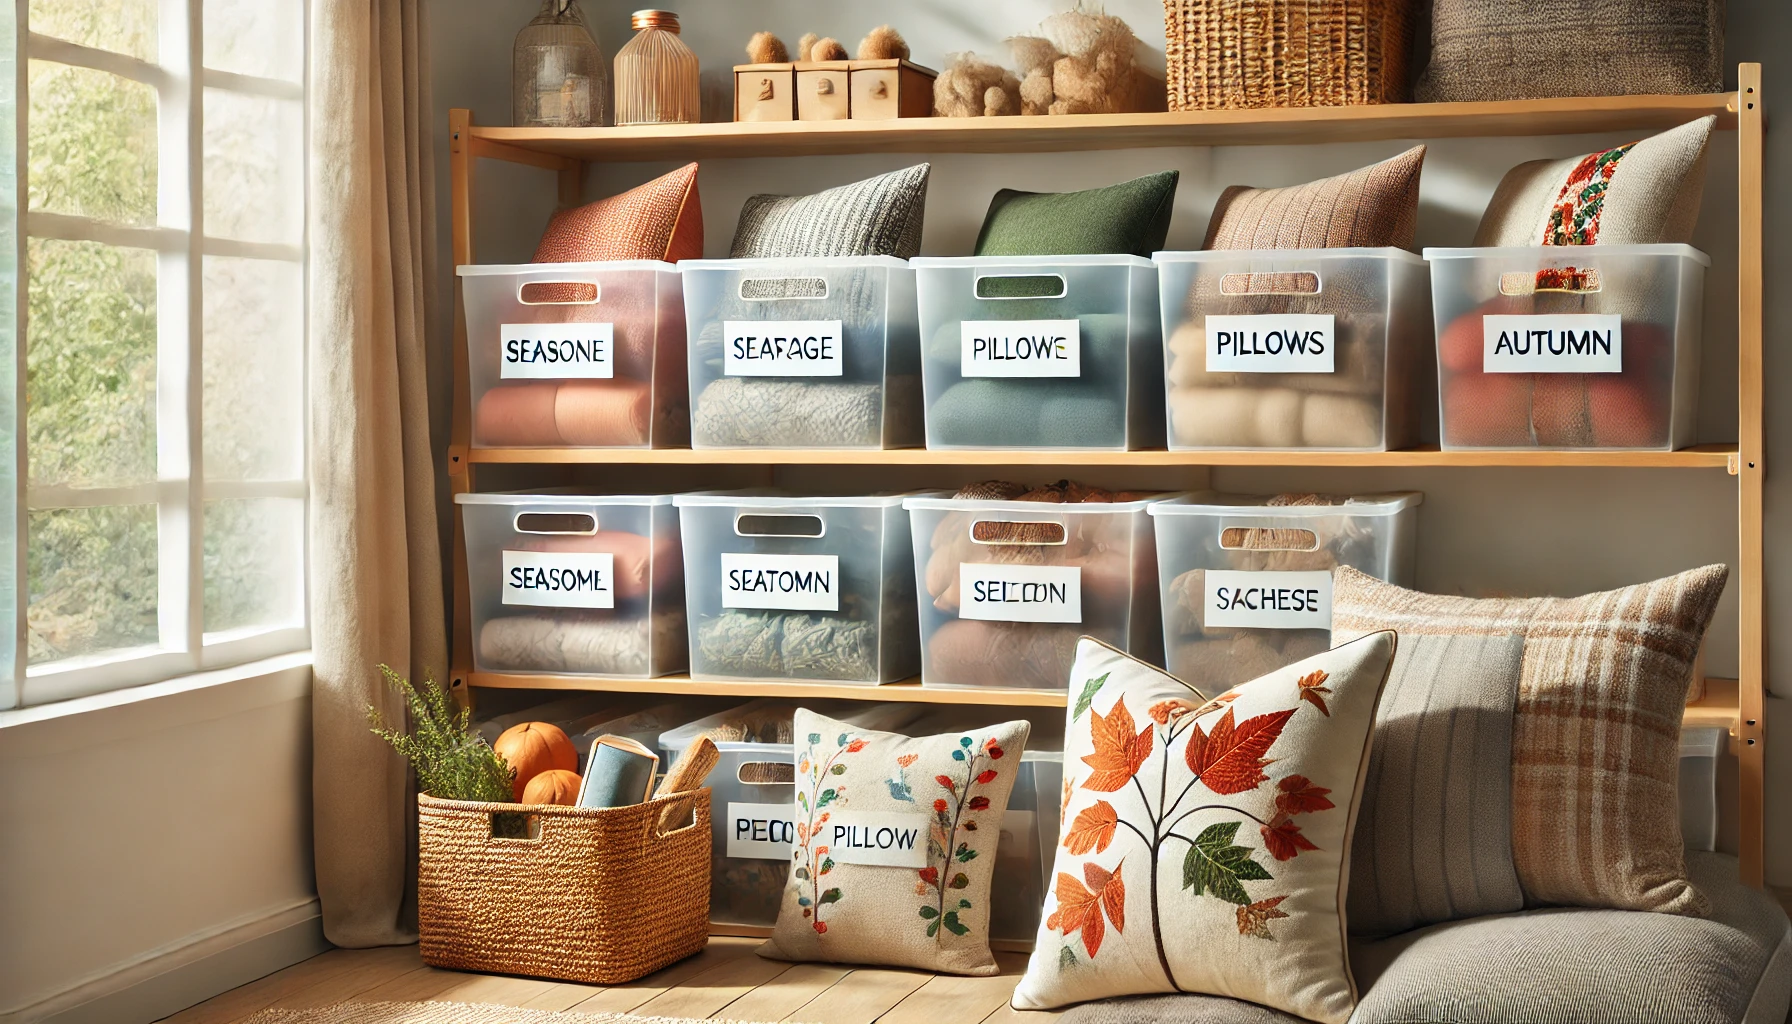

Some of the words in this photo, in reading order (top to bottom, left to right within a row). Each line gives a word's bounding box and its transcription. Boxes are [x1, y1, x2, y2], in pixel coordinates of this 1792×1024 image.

[506, 339, 605, 364] SEASONE
[1217, 329, 1325, 358] PILLOWS
[1494, 329, 1612, 356] AUTUMN
[729, 569, 830, 594] SEATOMN
[1216, 587, 1319, 613] SACHESE
[833, 825, 918, 851] PILLOW
